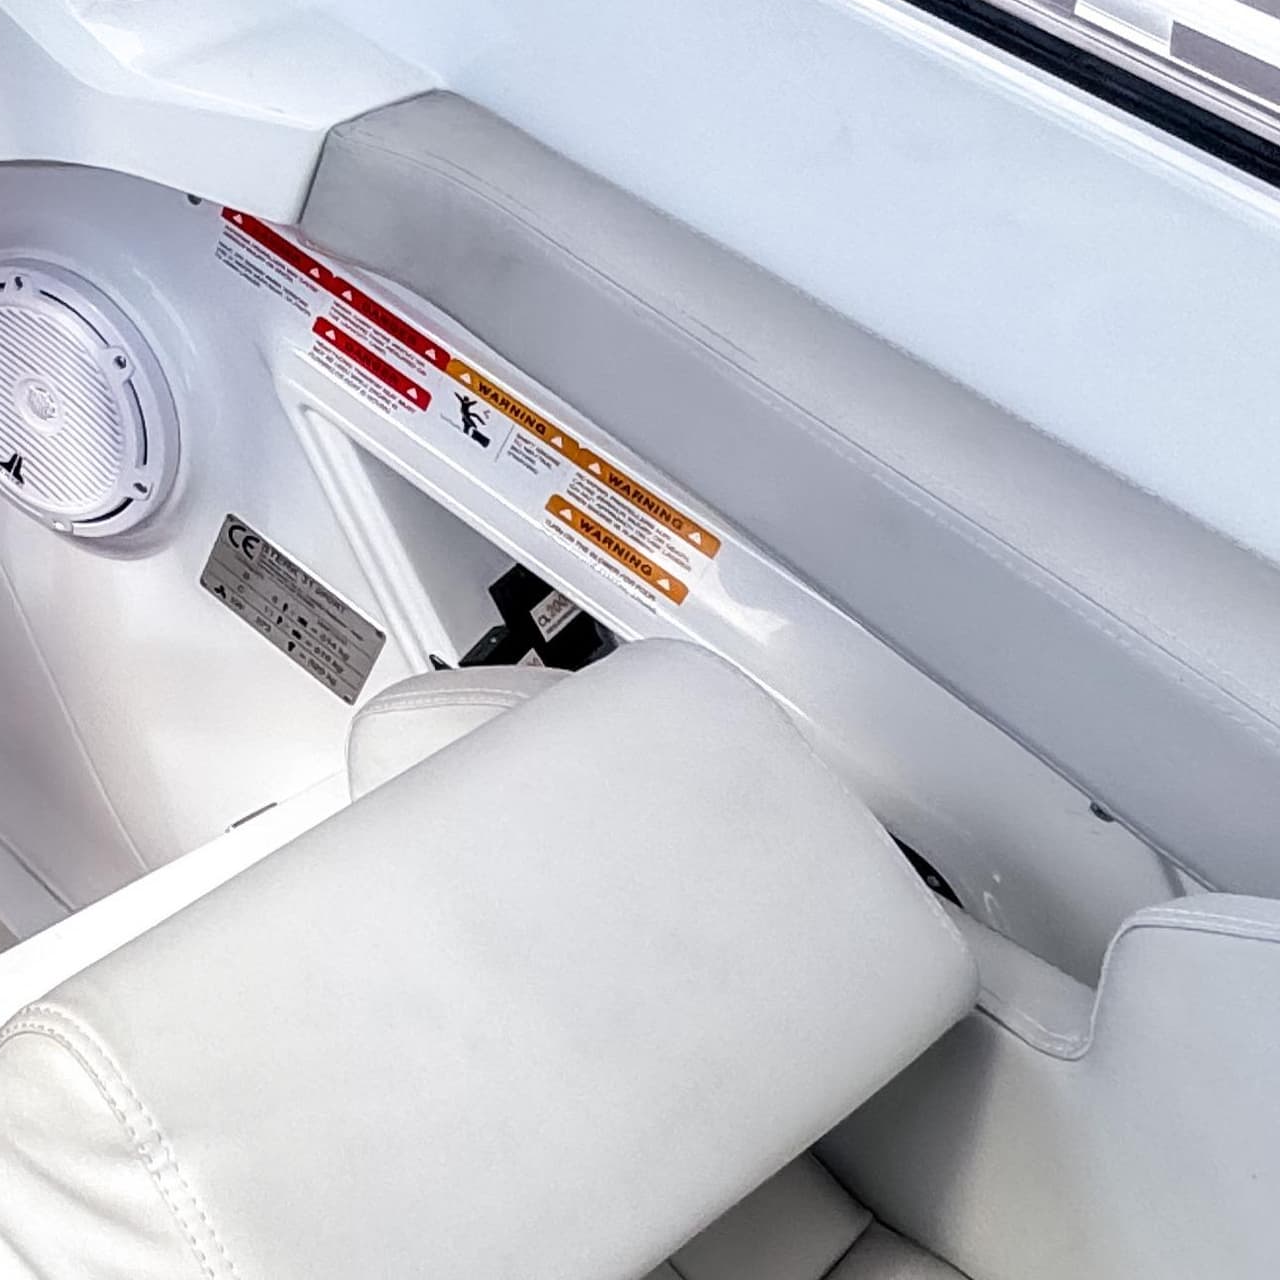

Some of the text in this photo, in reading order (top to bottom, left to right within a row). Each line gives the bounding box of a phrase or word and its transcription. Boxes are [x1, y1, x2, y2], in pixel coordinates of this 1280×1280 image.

[478, 382, 547, 436] WARNING
[608, 472, 684, 531] WARNING
[228, 524, 261, 560] CE
[579, 518, 653, 577] WARNING
